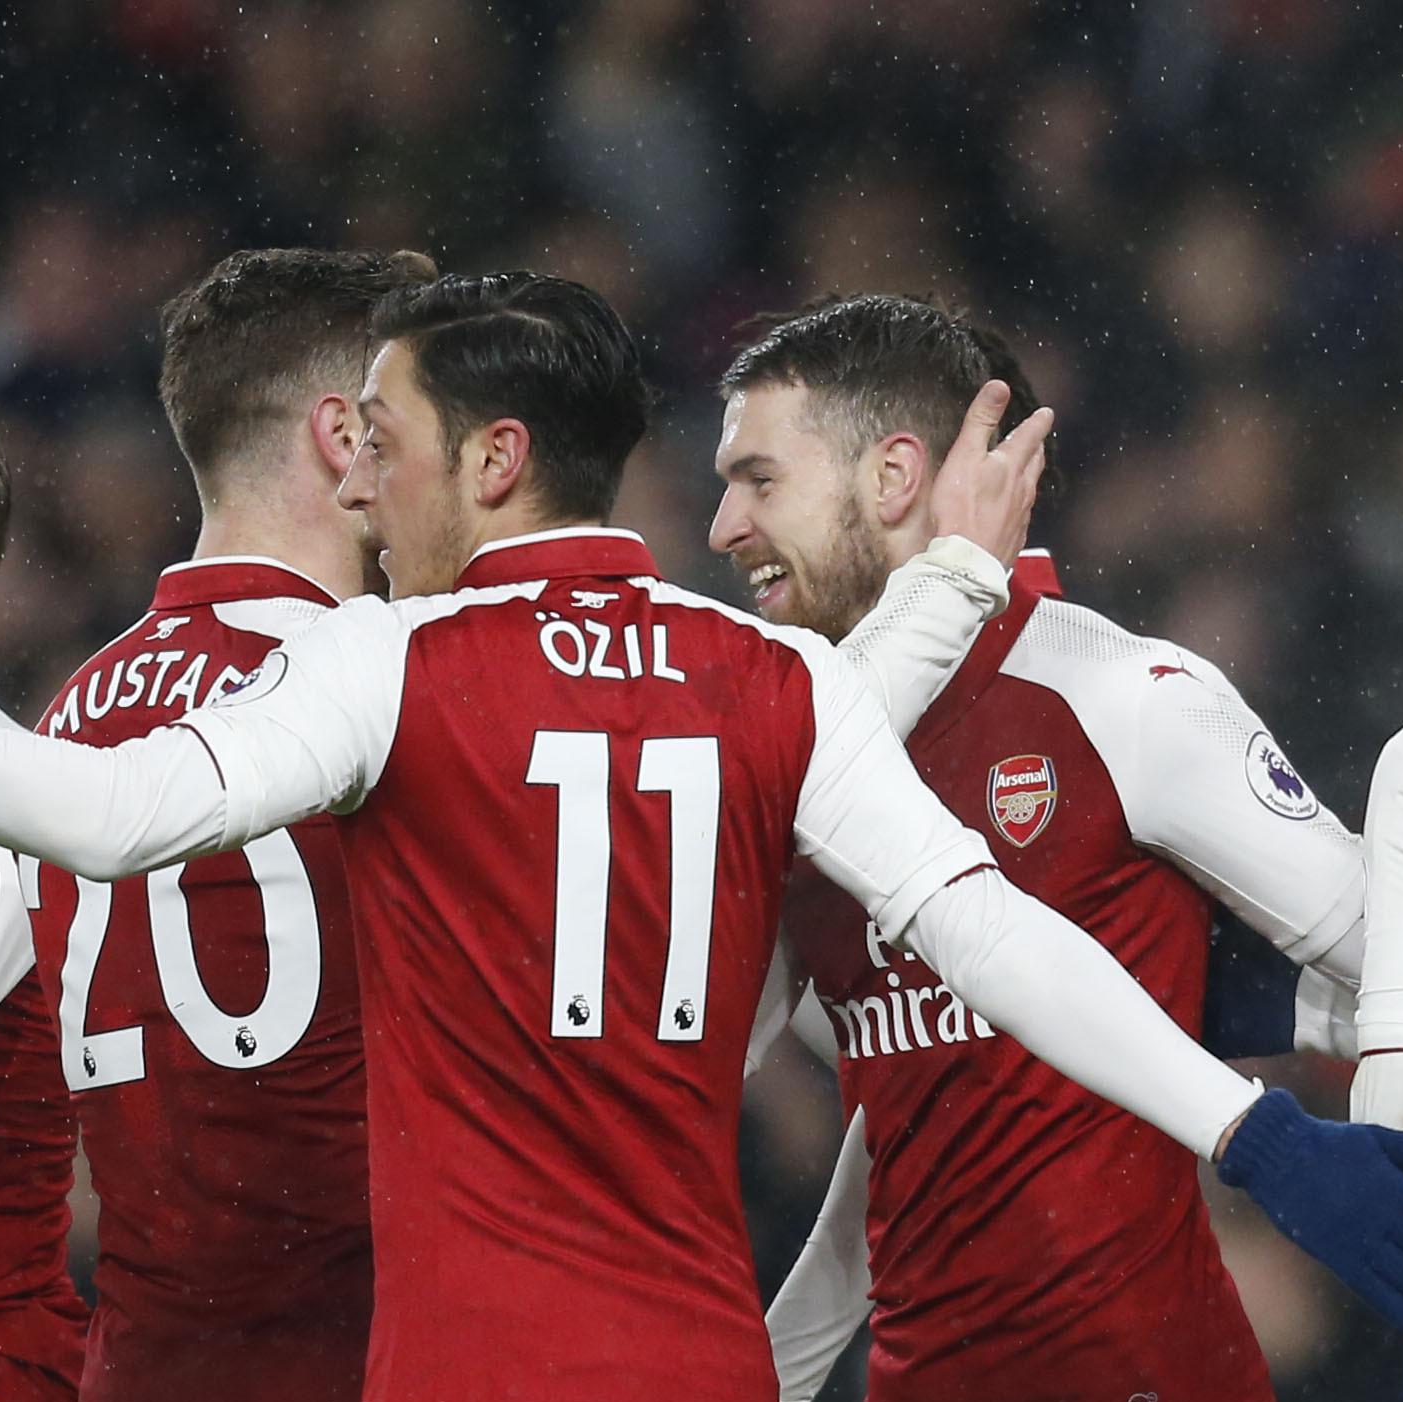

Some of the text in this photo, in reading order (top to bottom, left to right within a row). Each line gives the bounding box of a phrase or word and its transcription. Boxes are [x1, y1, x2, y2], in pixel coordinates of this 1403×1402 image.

[534, 610, 687, 684] ÖZIL
[996, 767, 1047, 788] Arsenal
[524, 729, 723, 1042] 11
[819, 971, 997, 1060] mira
